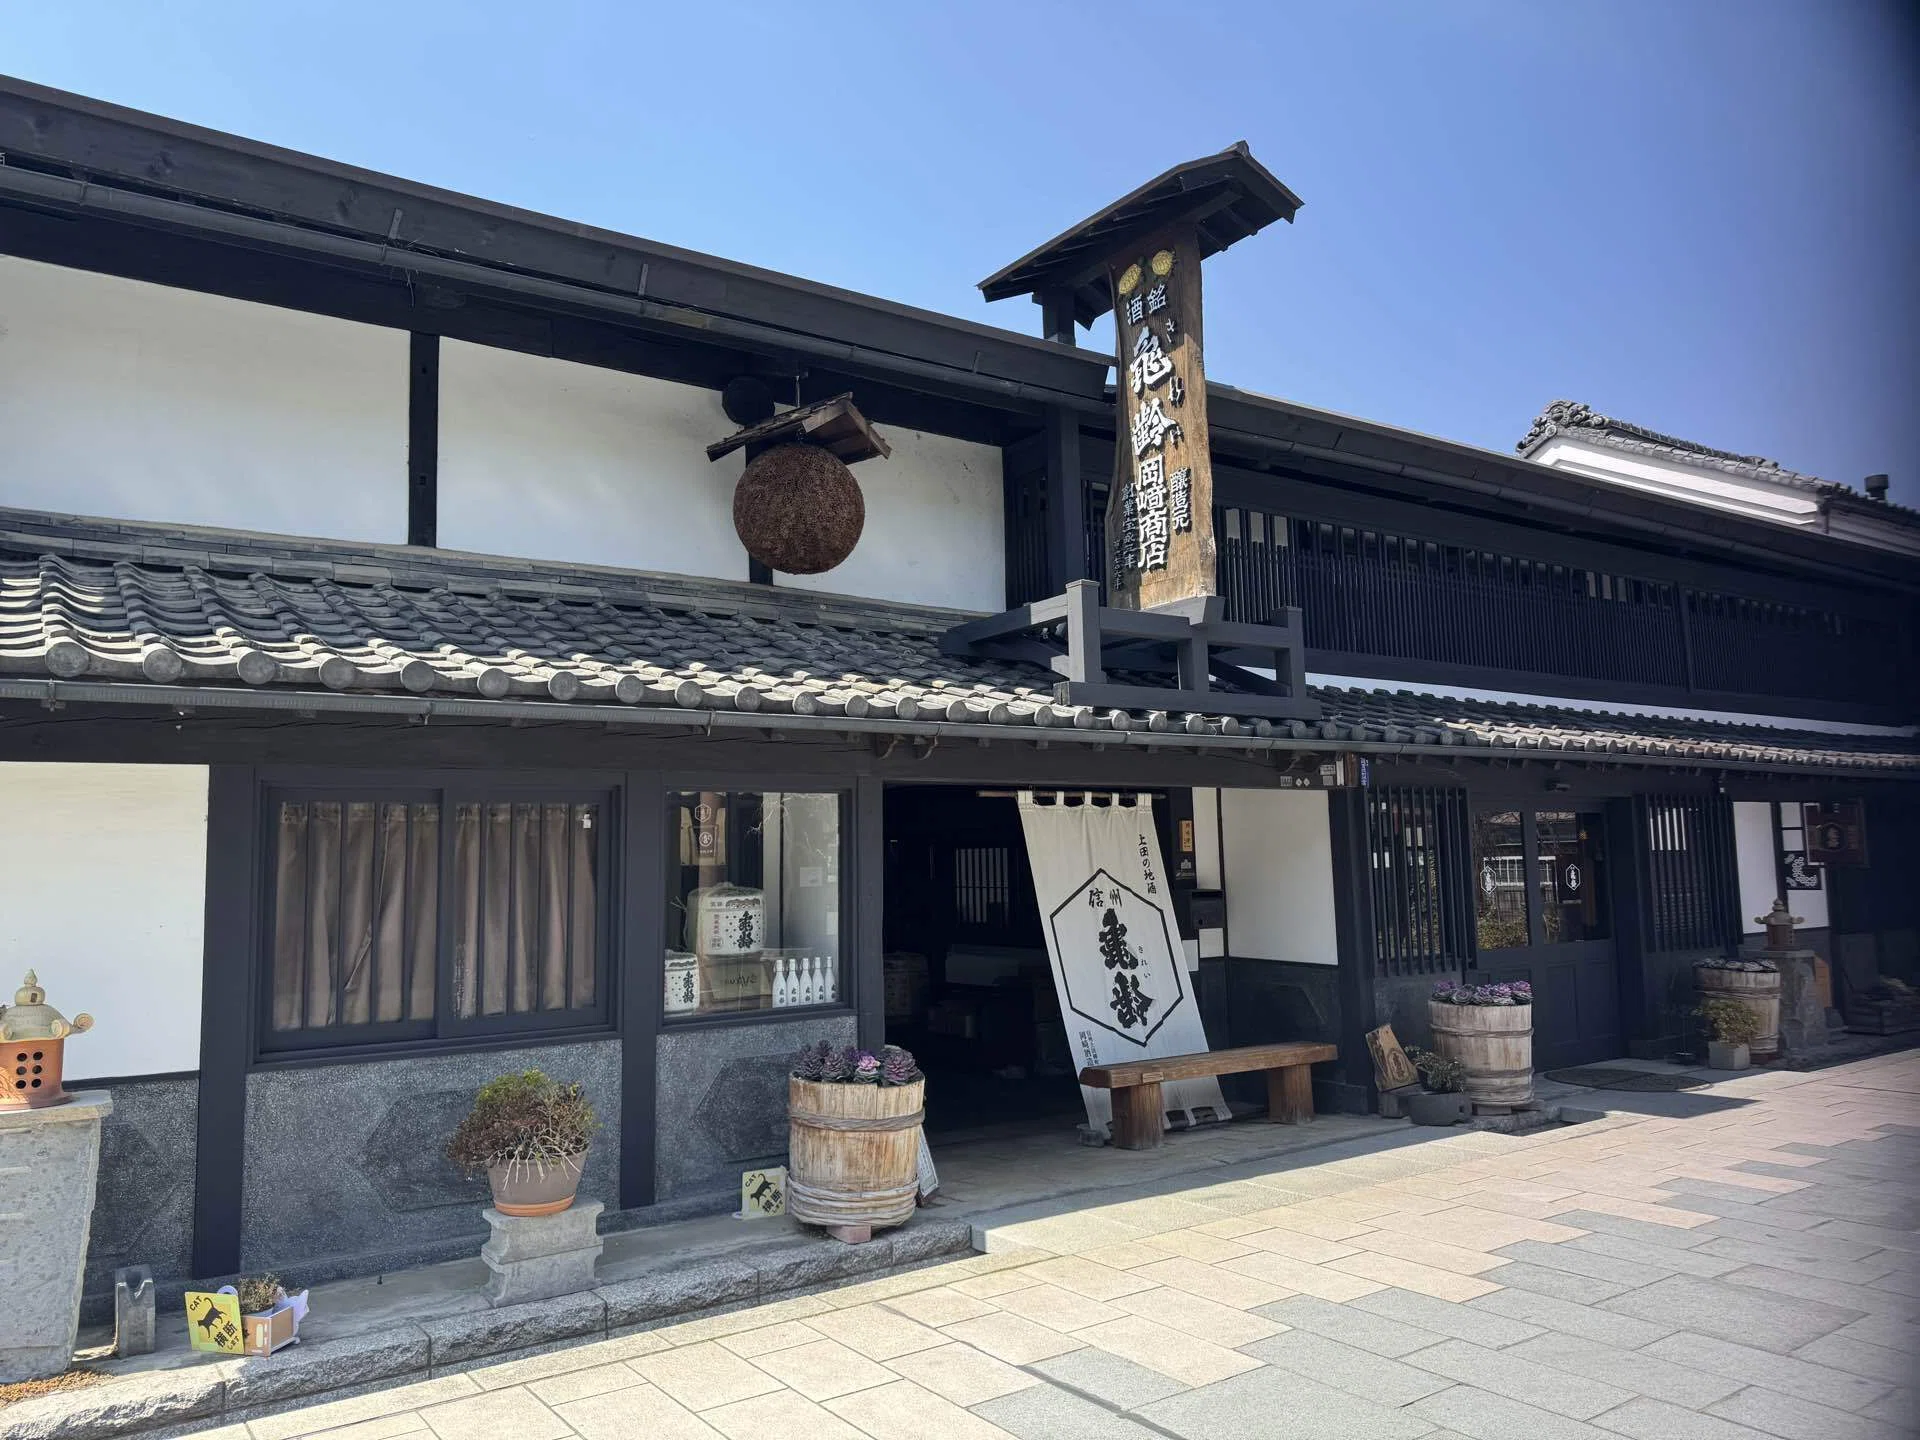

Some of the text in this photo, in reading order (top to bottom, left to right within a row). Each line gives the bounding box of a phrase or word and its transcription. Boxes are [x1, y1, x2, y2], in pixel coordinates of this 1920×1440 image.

[1138, 833, 1157, 895] 上田の地酒
[1088, 887, 1123, 908] 信州
[1137, 945, 1151, 980] きれい
[744, 1173, 757, 1188] CAT
[189, 1296, 203, 1312] CAT
[213, 1320, 238, 1349] 横断
